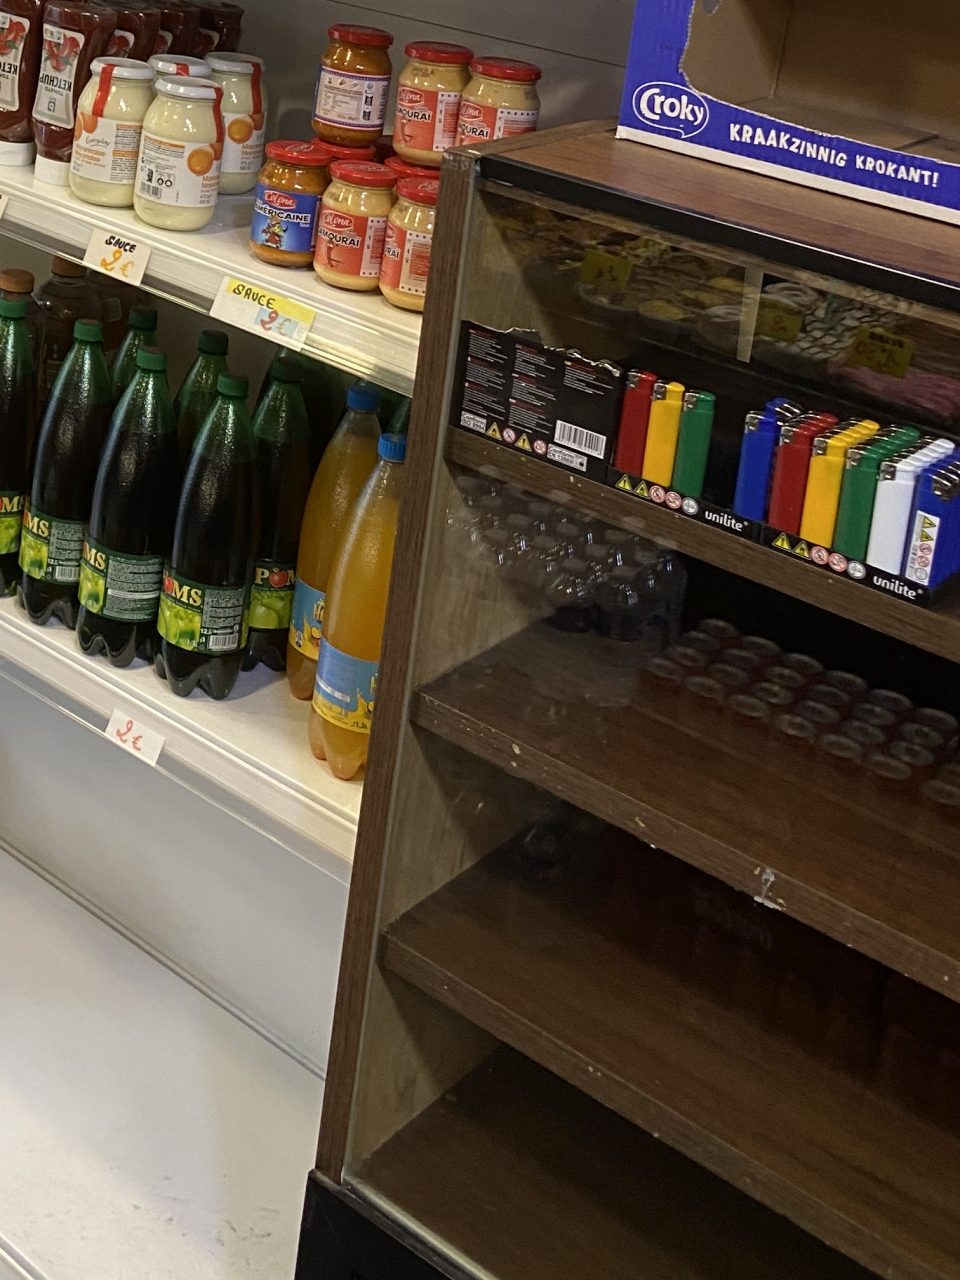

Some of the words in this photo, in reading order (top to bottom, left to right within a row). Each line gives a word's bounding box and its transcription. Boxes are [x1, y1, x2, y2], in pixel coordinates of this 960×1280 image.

[640, 88, 704, 126] Croky
[729, 123, 847, 167] KRAAKZINNIG
[855, 154, 939, 188] KROKANT!
[232, 283, 276, 310] SAUCE
[704, 509, 744, 531] unilite
[873, 574, 917, 600] unilite
